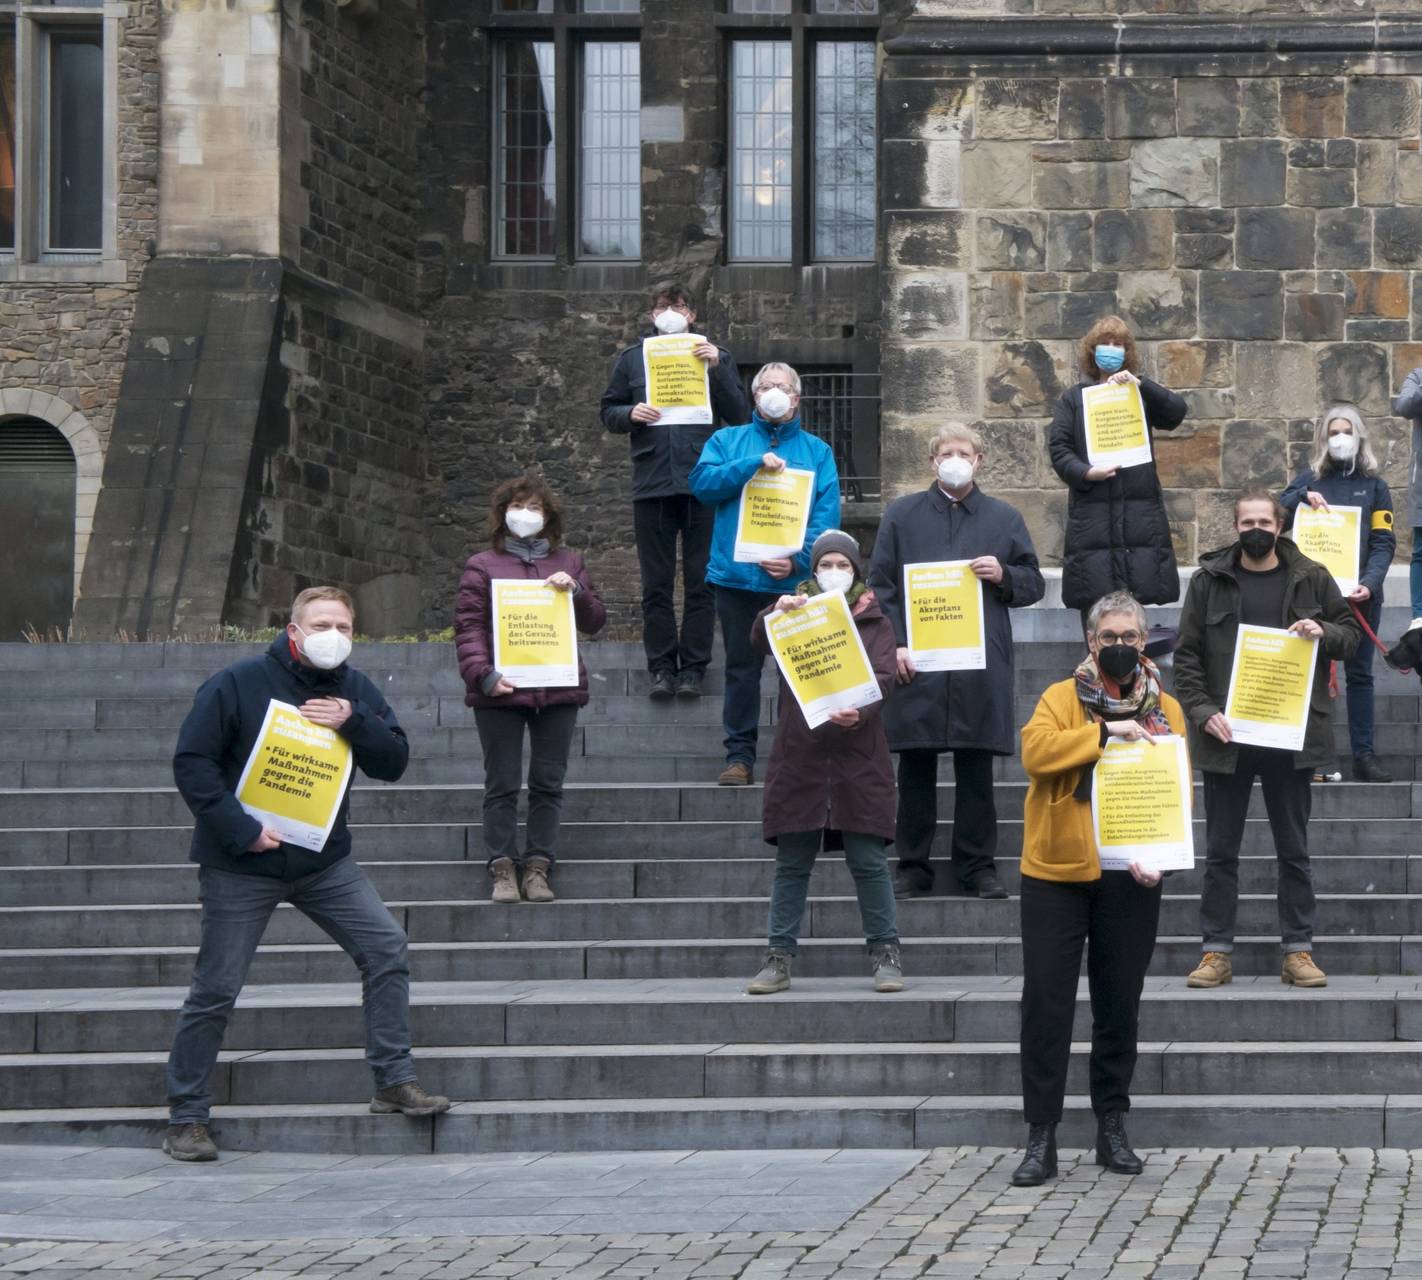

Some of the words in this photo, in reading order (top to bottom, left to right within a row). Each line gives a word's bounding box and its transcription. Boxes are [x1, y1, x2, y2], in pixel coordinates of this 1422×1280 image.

[787, 645, 802, 655] Für
[804, 630, 847, 649] wirksame
[791, 640, 847, 663] Maßnahmen
[795, 658, 821, 674] gegen
[823, 654, 836, 663] die
[798, 663, 842, 682] Pandemie
[267, 757, 332, 781] Maßnahmen
[272, 746, 290, 758] Für
[292, 753, 339, 772] wirksame
[259, 778, 311, 799] Pandemie
[263, 768, 295, 783] gegen
[298, 776, 314, 787] die
